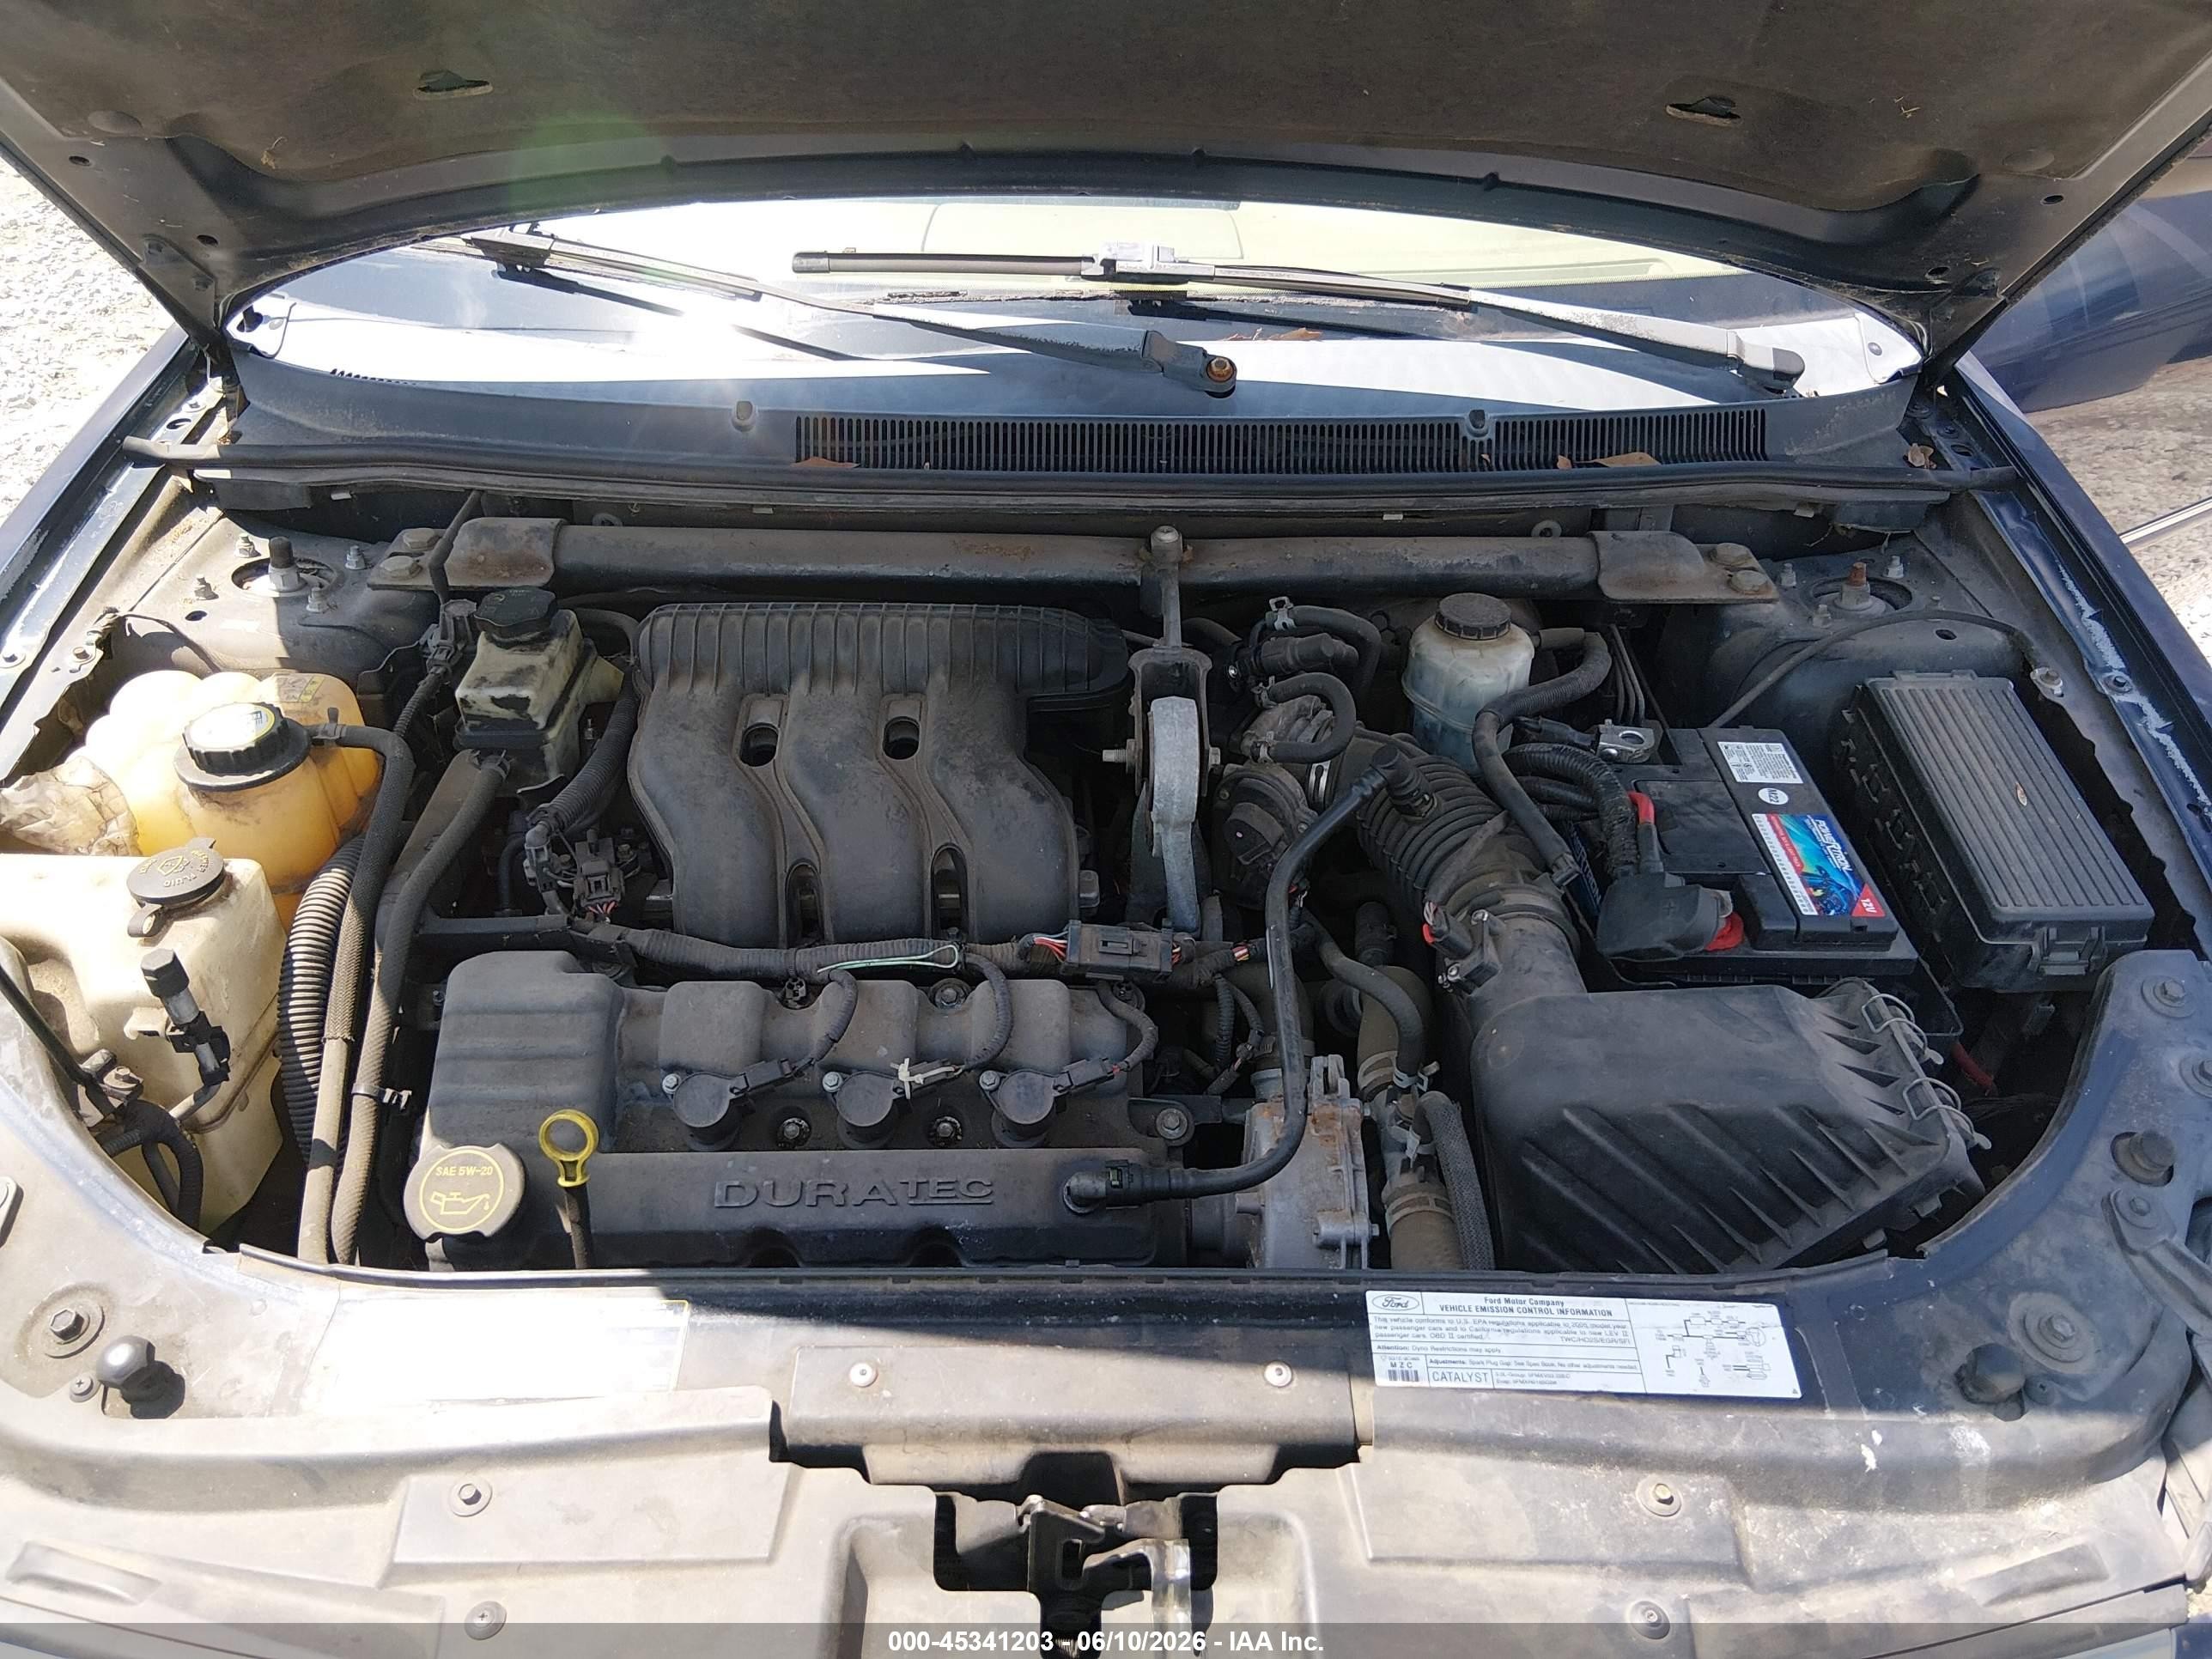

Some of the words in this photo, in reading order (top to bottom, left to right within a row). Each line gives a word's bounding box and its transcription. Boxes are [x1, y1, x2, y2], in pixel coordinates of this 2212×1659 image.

[1767, 788, 1779, 803] M22
[163, 872, 198, 887] FLUID
[1860, 898, 1876, 913] 12V
[435, 1166, 457, 1176] SAE
[458, 1166, 493, 1176] 5W-20
[714, 1177, 993, 1207] DURATEC
[1382, 1296, 1409, 1308] Ford
[1528, 1298, 1565, 1307] Company
[1475, 1305, 1514, 1314] EMISSION
[1431, 1371, 1488, 1382] CATALYST
